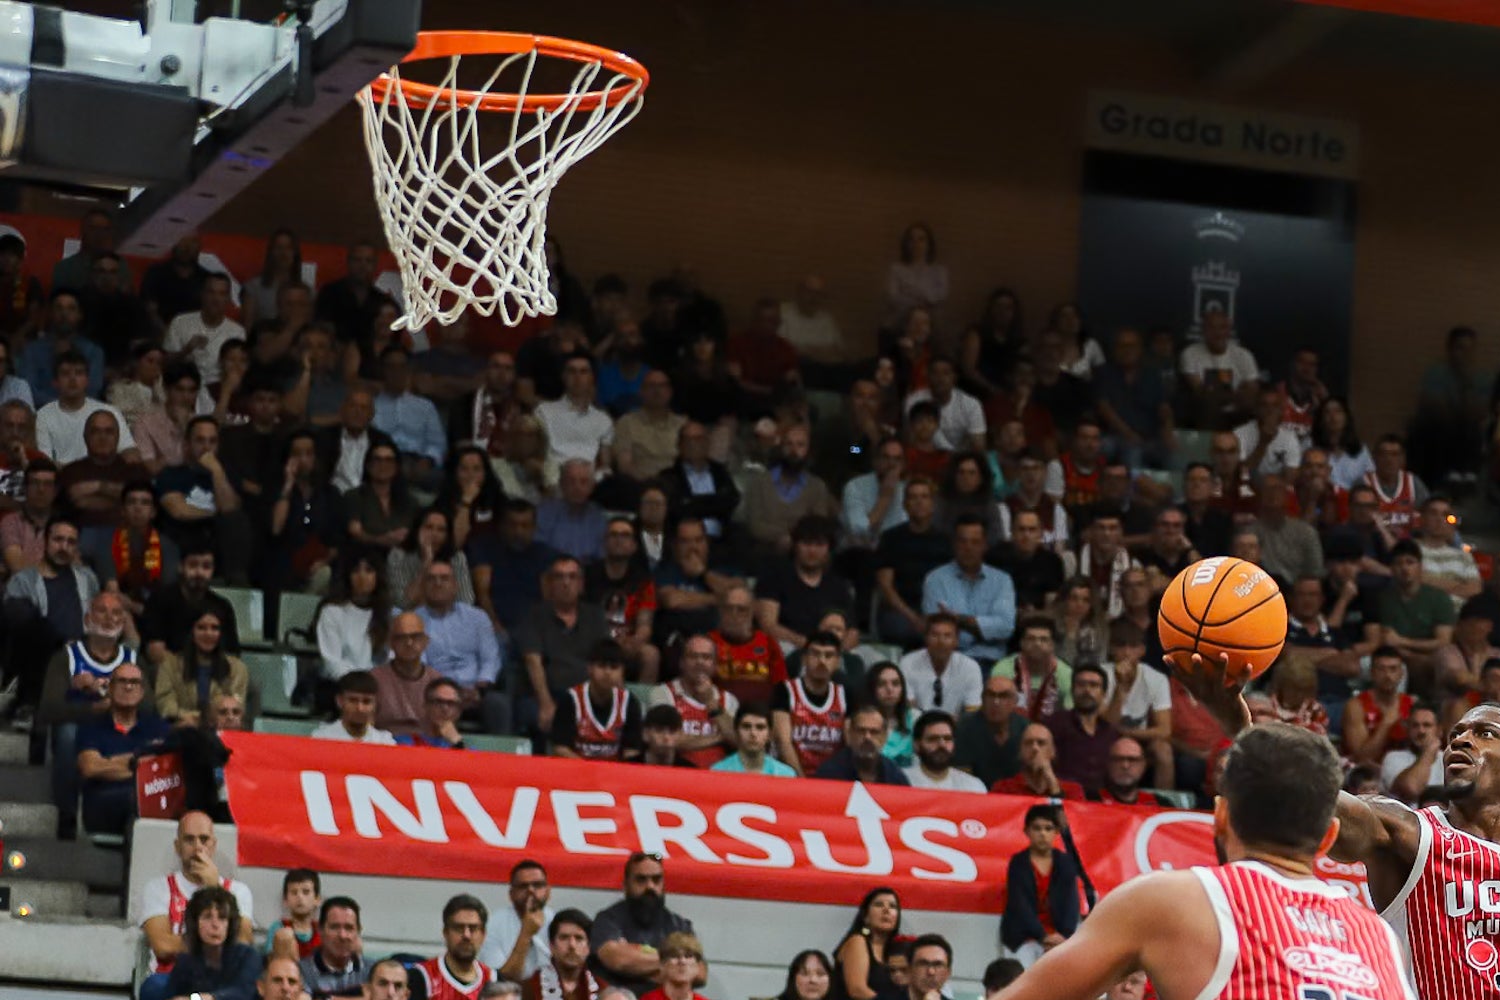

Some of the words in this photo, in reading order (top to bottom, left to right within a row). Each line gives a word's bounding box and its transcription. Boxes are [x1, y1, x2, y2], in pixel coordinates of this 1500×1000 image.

[1100, 102, 1223, 147] Grada
[1242, 120, 1345, 163] Norte
[300, 769, 979, 883] INVERSUS
